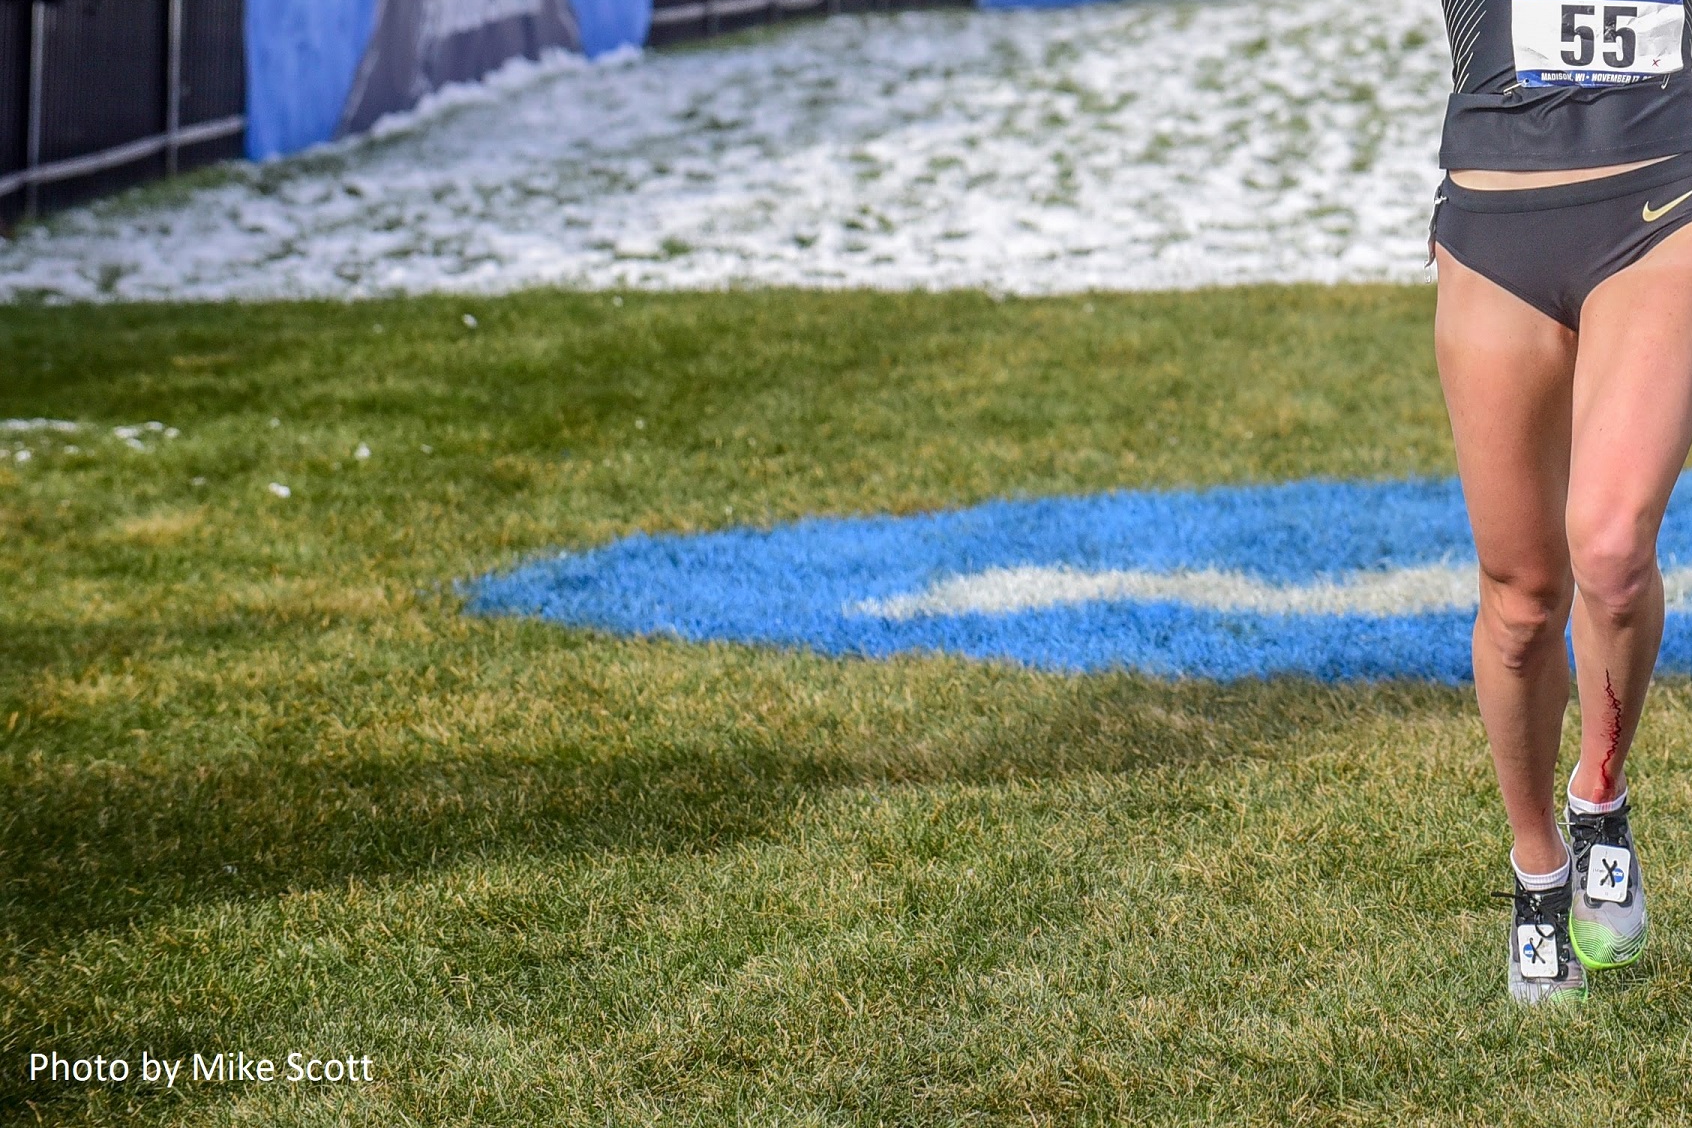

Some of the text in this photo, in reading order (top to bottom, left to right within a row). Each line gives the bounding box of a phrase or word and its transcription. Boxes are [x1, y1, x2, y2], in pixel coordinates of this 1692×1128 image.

[1560, 4, 1638, 68] 55
[1575, 73, 1586, 82] WI
[1591, 73, 1631, 83] NOVEMBER
